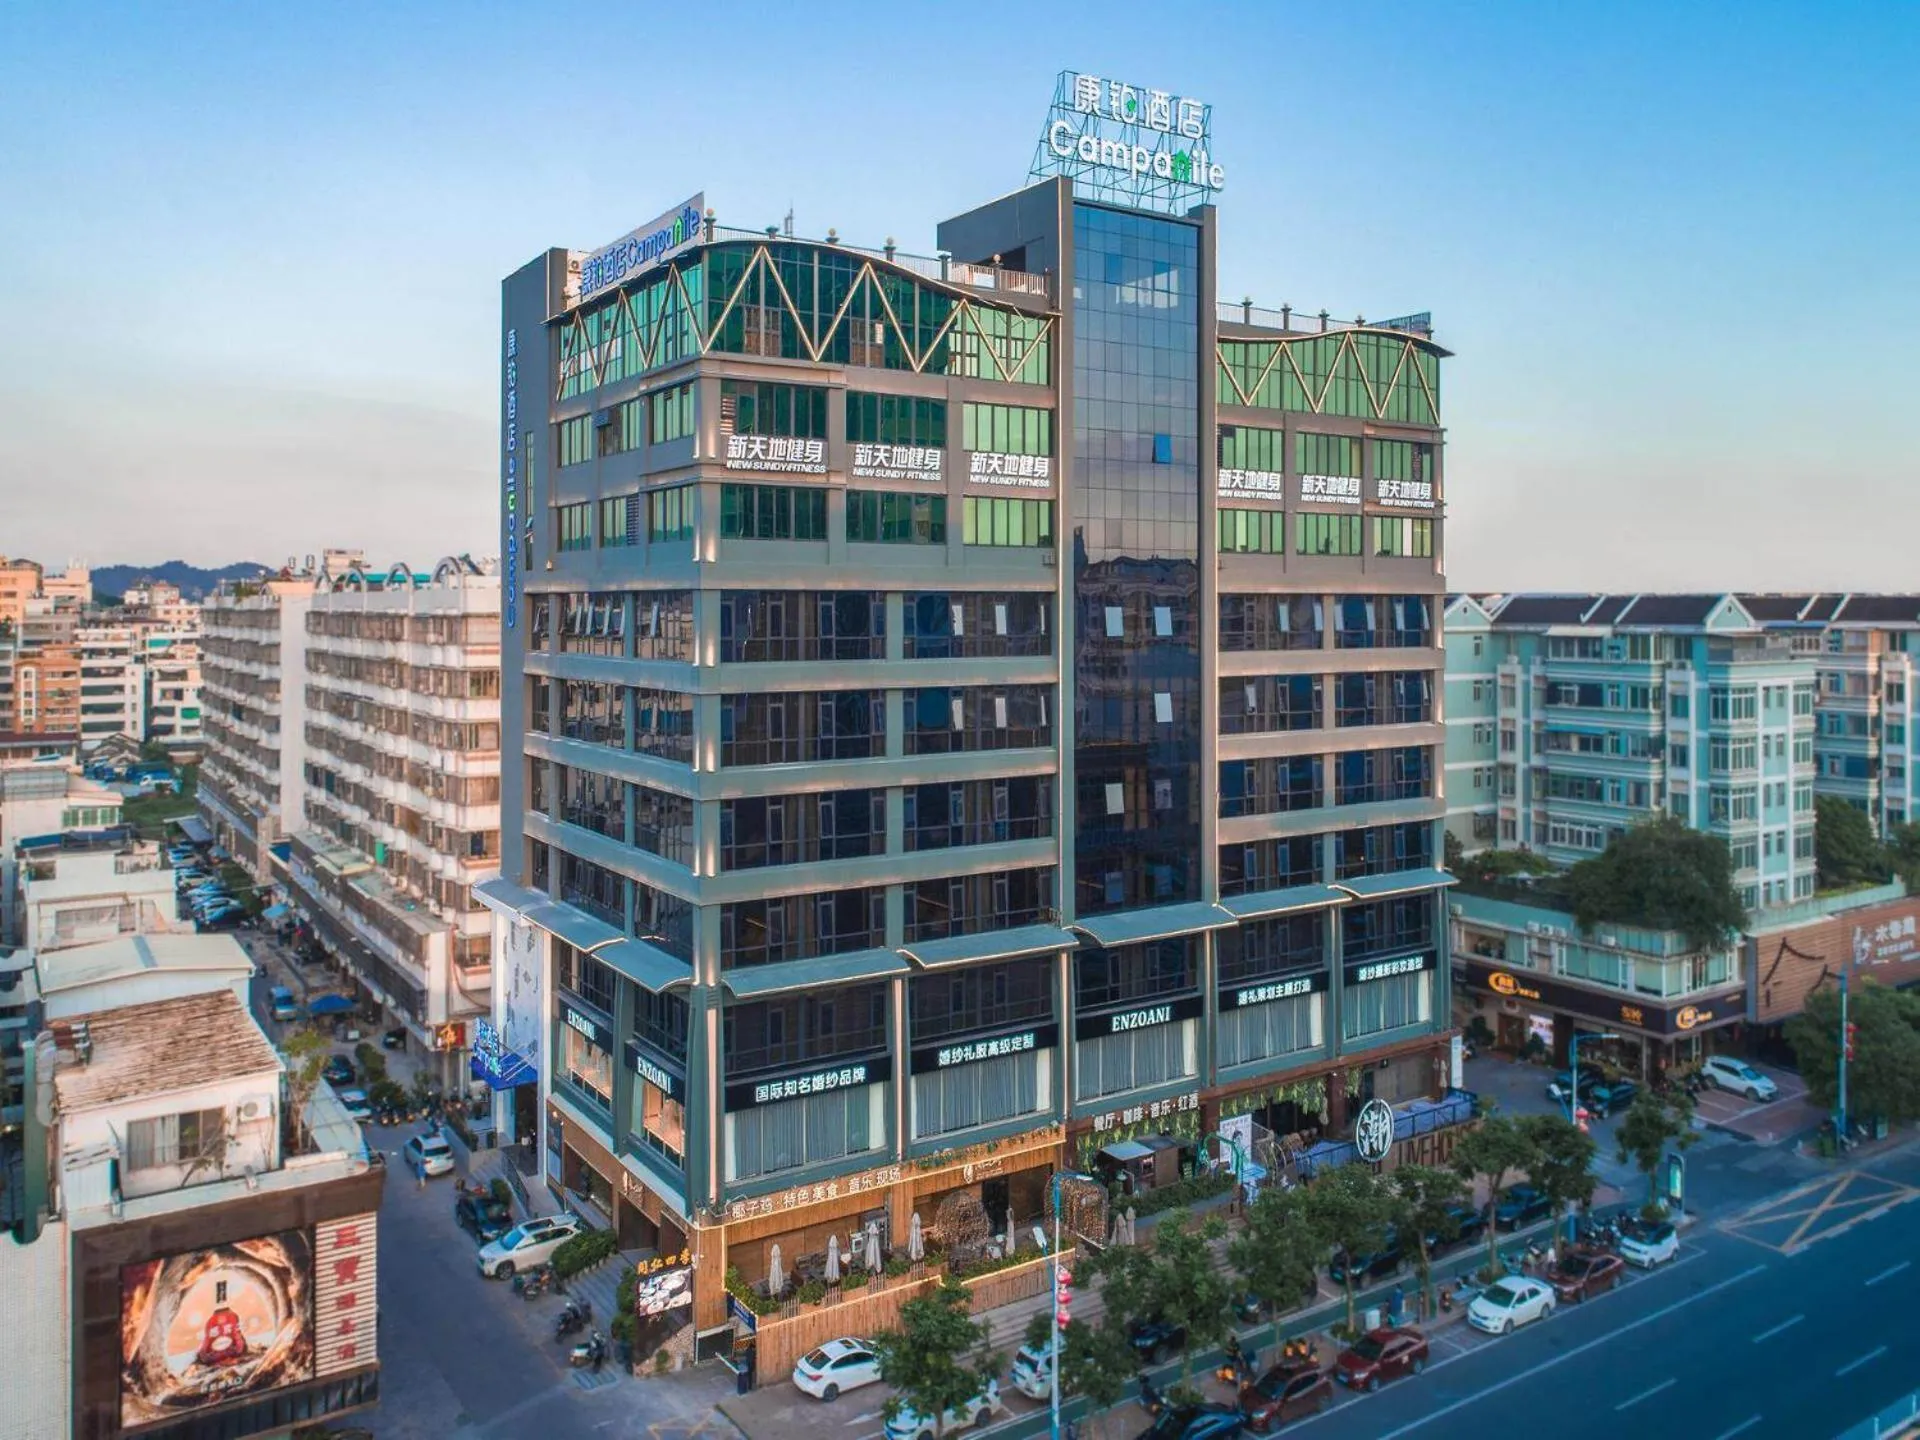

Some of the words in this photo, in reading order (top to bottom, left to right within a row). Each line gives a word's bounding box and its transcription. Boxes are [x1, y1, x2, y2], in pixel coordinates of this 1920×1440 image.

[1074, 74, 1204, 139] 康铂酒店
[1048, 119, 1225, 190] Campanile
[629, 206, 700, 268] Campanile
[727, 434, 823, 463] 新天地健身
[854, 444, 941, 471] 新天地健身
[727, 459, 752, 470] NEW
[786, 463, 827, 474] FITNESS
[852, 467, 875, 477] NEW
[970, 451, 1049, 478] 新天地健身
[1218, 471, 1281, 491] 新天地健身
[1112, 1006, 1171, 1032] ENZOANI
[938, 1033, 1034, 1067] 婚纱礼服高级定制
[637, 1056, 672, 1095] ENZOANI
[755, 1066, 866, 1102] 国际知名婚纱品牌
